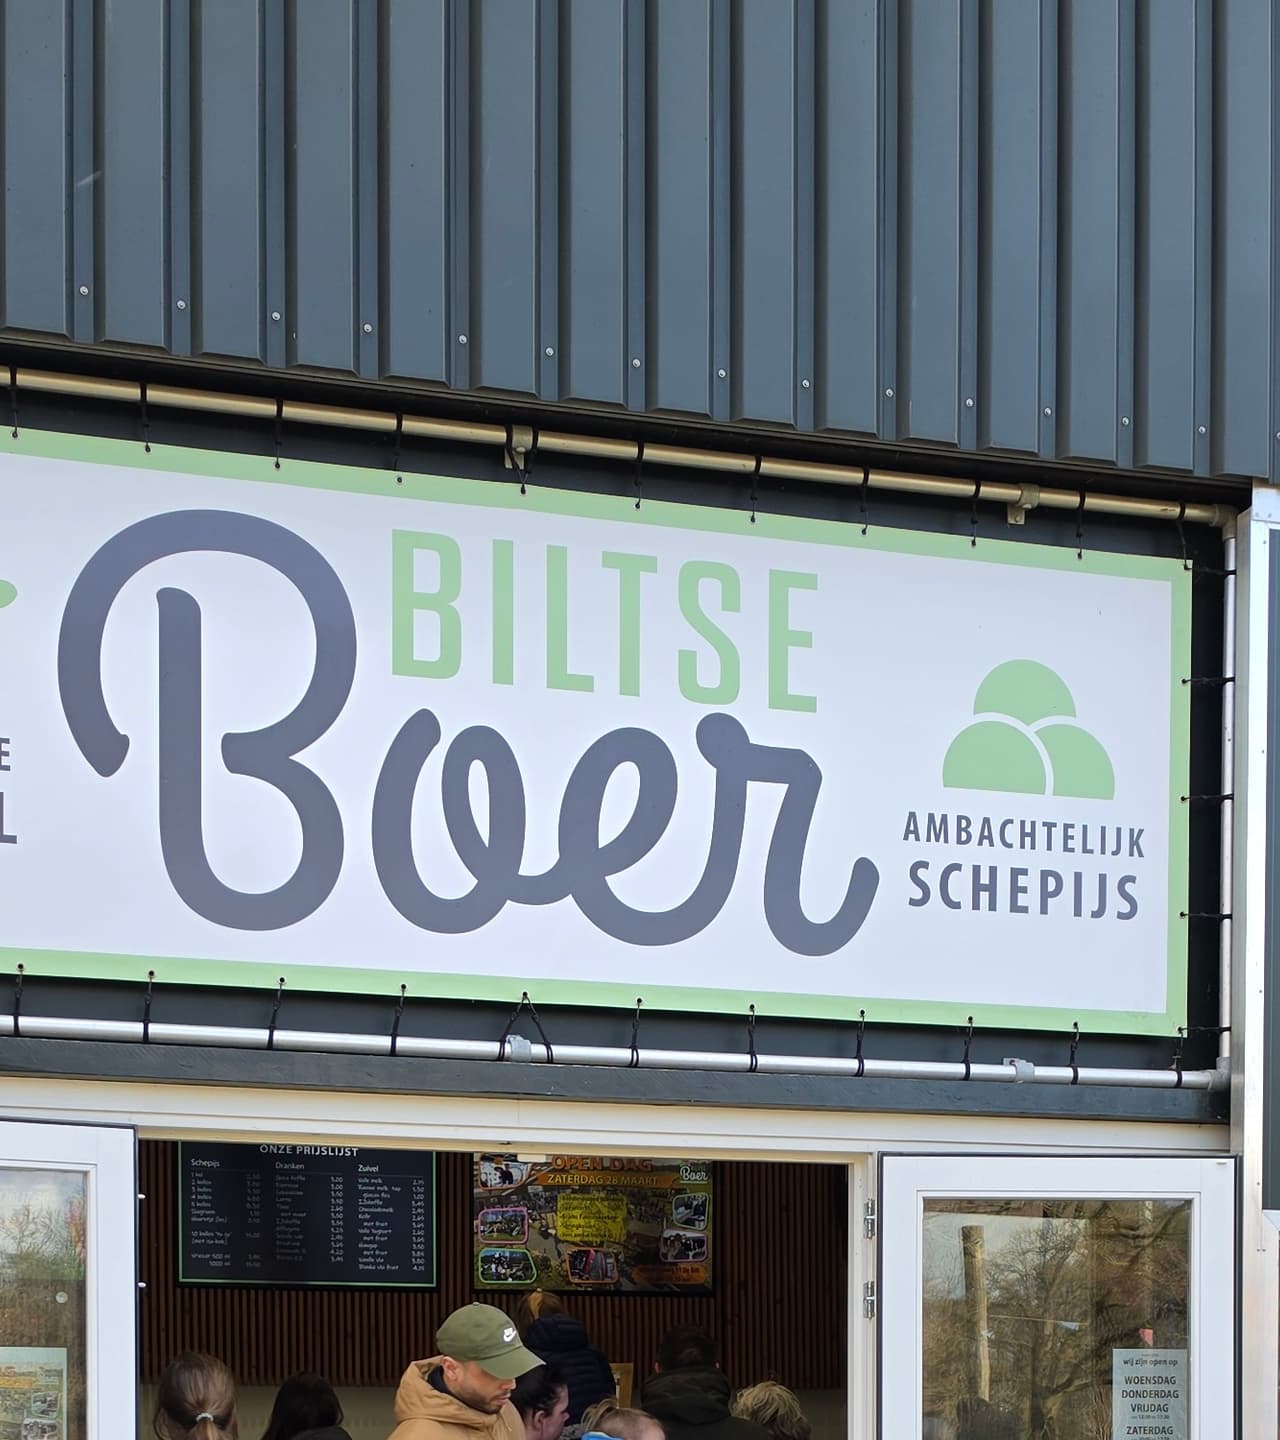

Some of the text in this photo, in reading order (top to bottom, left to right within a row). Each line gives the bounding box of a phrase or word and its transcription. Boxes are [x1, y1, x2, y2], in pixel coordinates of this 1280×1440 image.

[390, 528, 818, 713] BILTSE
[57, 508, 880, 957] Boer
[902, 811, 1145, 858] AMBACHTELIJK
[908, 860, 1139, 921] SCHEPIJS
[259, 1144, 359, 1157] ONZE PRIJSLIJST
[190, 1158, 221, 1169] Schepijs
[275, 1161, 305, 1170] Dranken
[357, 1163, 380, 1173] Zuivel
[551, 1155, 654, 1172] OPEN DAG
[679, 1165, 709, 1179] Boer
[547, 1174, 659, 1186] ZATERDAG 28 MAART
[1123, 1358, 1134, 1367] wij
[1135, 1358, 1148, 1367] zijn
[1124, 1376, 1177, 1385] WOENSDAG
[1121, 1390, 1180, 1399] DONDERDAG
[1130, 1403, 1169, 1413] VRIJDAG
[1126, 1426, 1174, 1435] ZATERDAG
